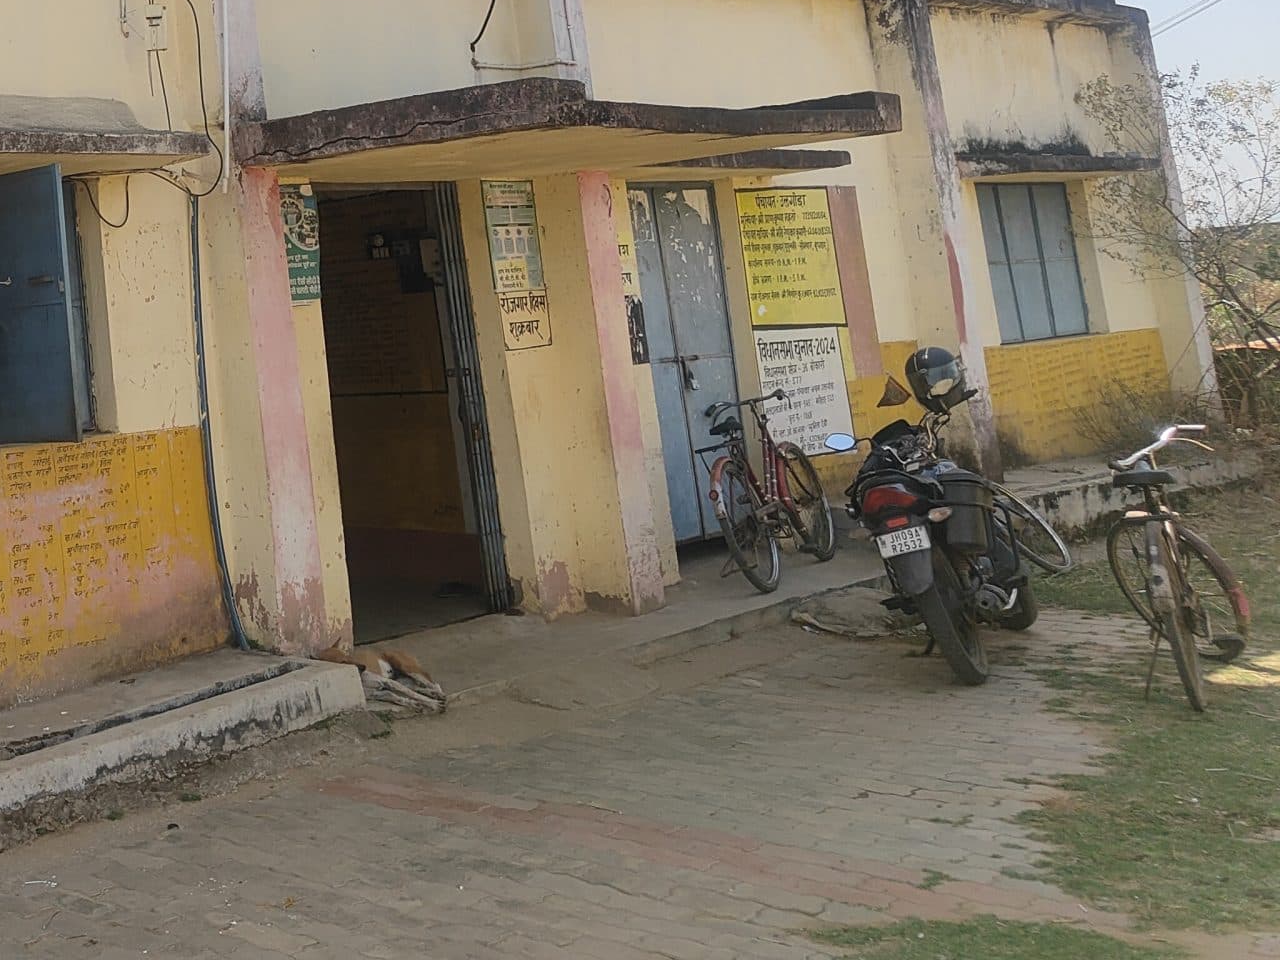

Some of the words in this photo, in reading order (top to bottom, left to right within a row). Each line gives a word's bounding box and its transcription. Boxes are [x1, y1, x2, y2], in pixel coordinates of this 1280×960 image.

[757, 337, 794, 362] विधानसभा
[890, 527, 921, 544] JH09A
[891, 538, 924, 554] R2532
